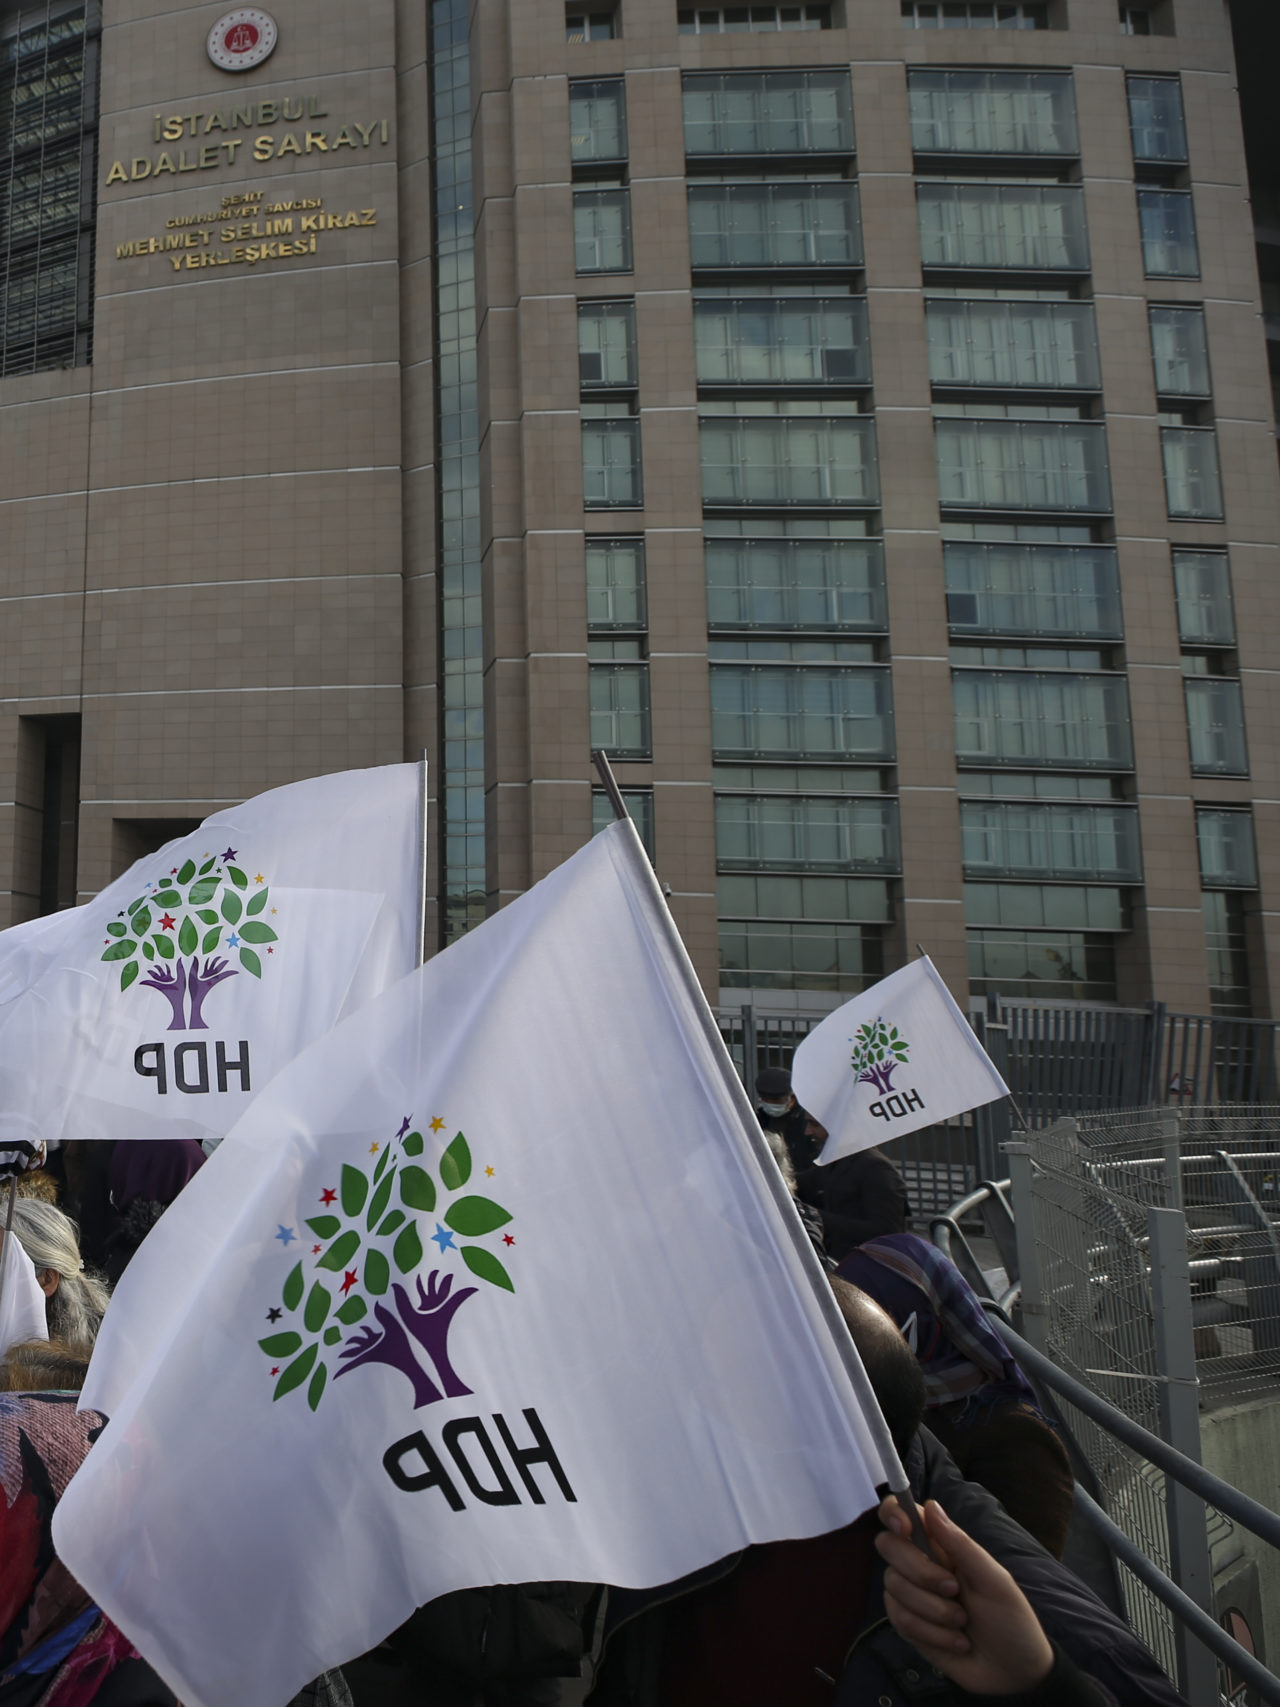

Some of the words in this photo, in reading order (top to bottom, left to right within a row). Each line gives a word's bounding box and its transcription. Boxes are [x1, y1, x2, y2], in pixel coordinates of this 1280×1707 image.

[153, 94, 328, 143] İSTANBUL
[105, 139, 242, 186] ADALET
[253, 120, 389, 161] SARAYI
[116, 230, 213, 260] MEHMET
[220, 218, 292, 243] SELİM
[301, 209, 377, 234] KİRAZ
[170, 234, 317, 271] YERLEŞKESİ
